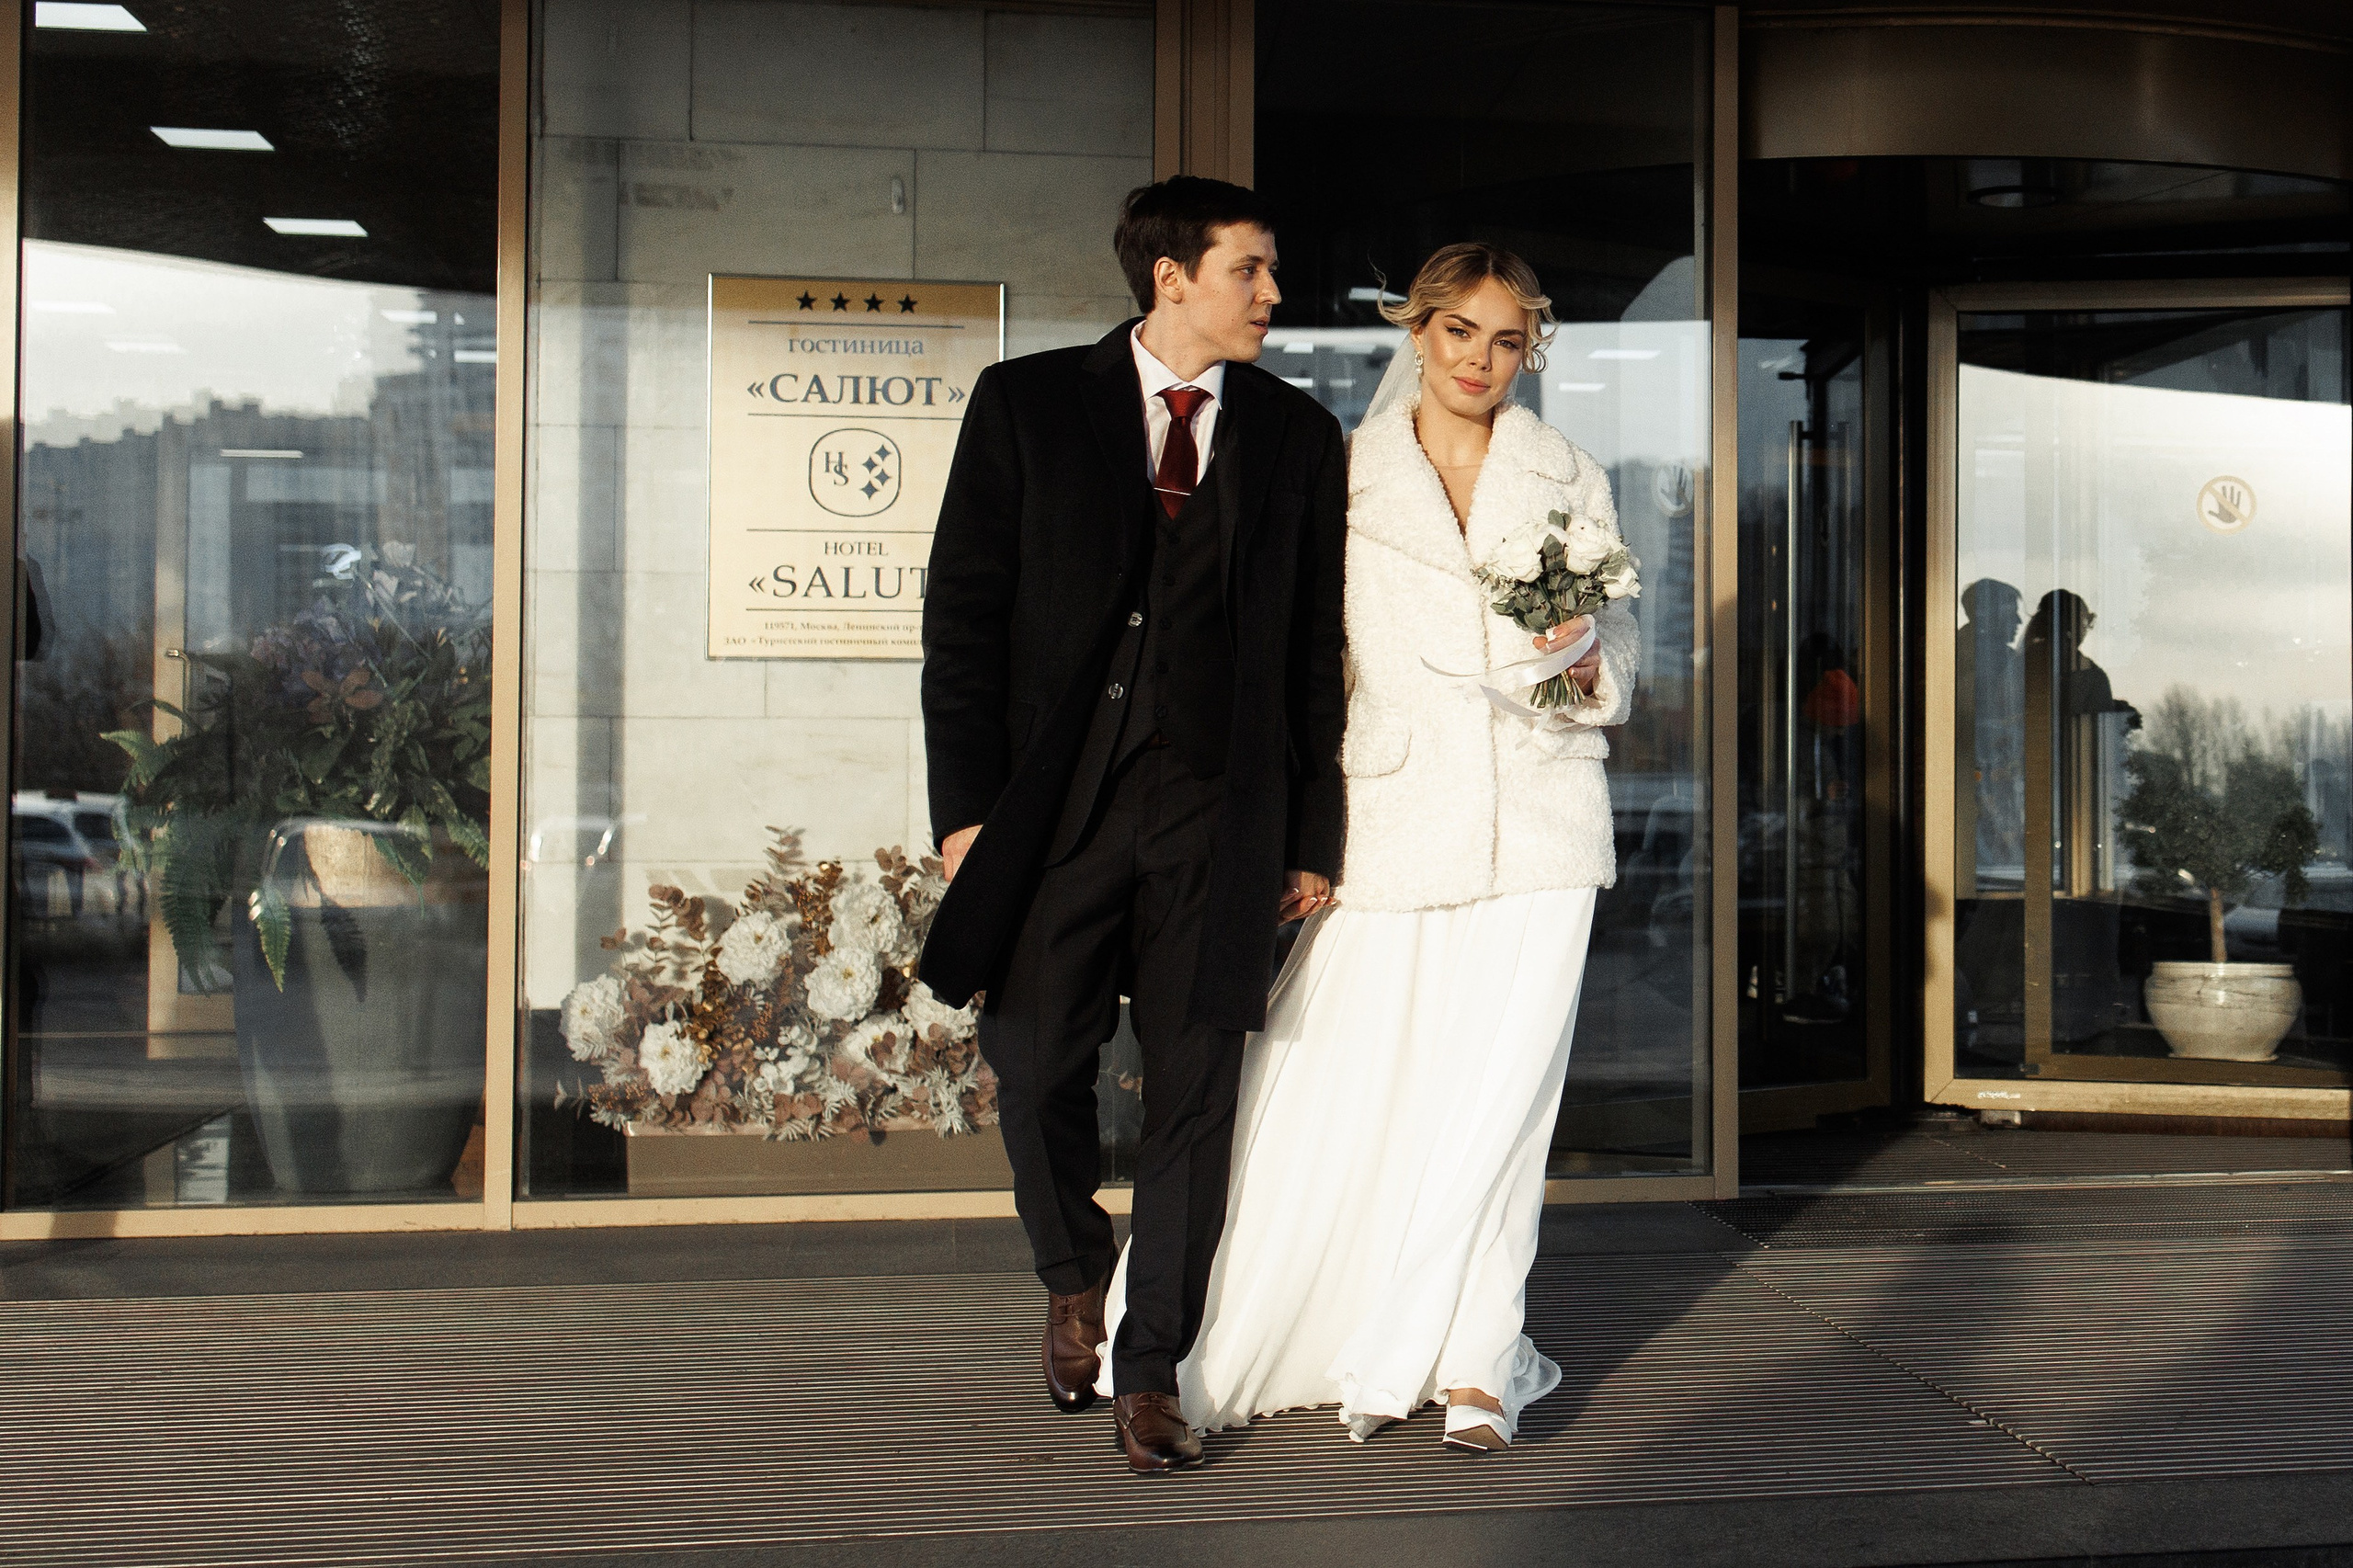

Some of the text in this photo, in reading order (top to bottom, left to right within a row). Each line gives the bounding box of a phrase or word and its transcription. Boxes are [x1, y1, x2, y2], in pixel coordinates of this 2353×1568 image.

[789, 338, 924, 357] гостиница
[747, 373, 965, 405] «САЛЮТ»
[824, 541, 889, 556] HOTEL
